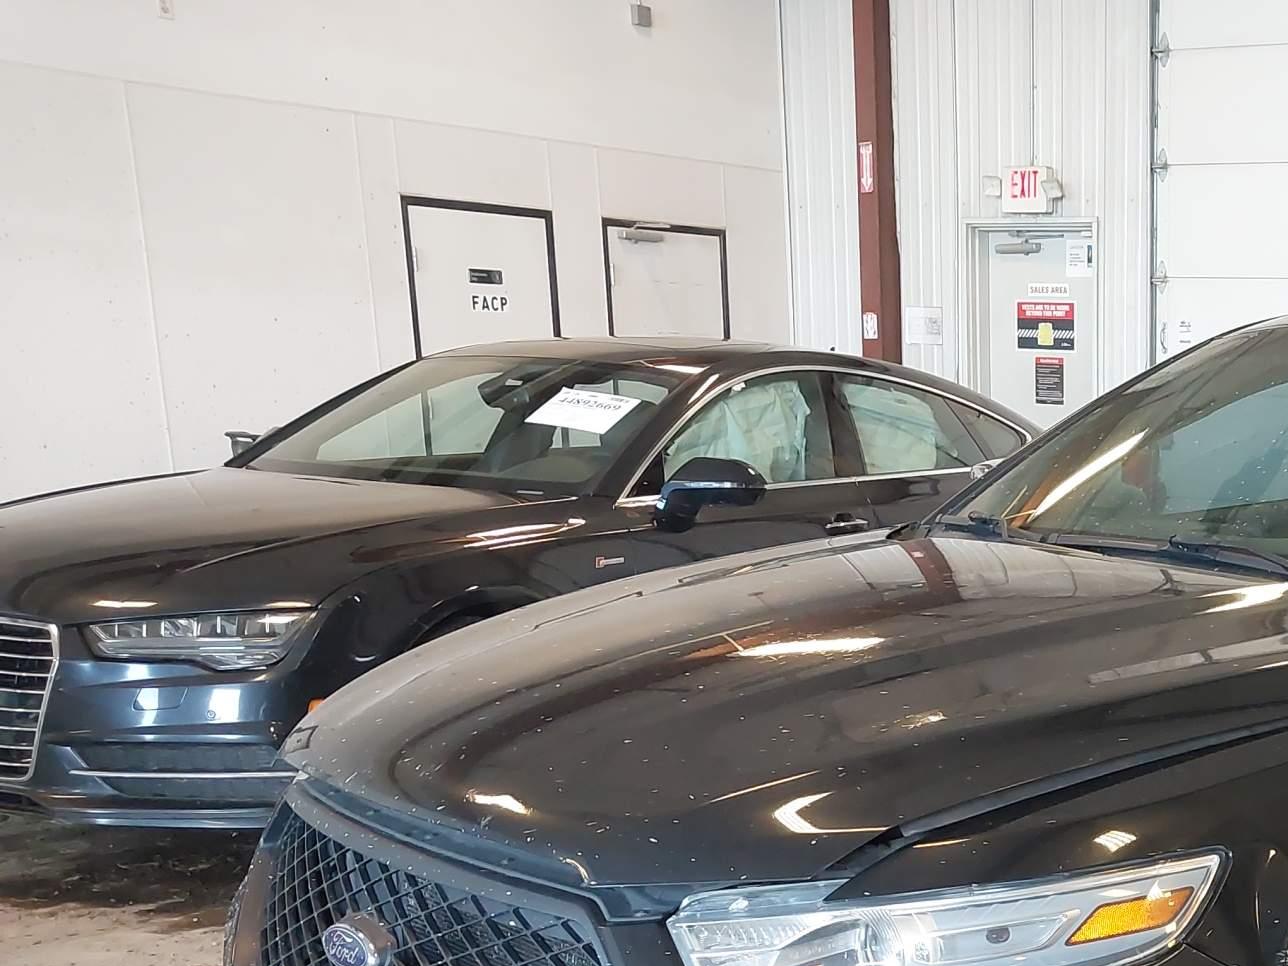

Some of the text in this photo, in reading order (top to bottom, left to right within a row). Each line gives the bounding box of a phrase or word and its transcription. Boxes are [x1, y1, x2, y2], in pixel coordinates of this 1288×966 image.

[1011, 170, 1039, 199] EXIT
[1030, 286, 1067, 294] SALES AREA
[472, 295, 508, 312] FACP
[558, 397, 622, 411] 44892669
[330, 930, 359, 965] Ford
